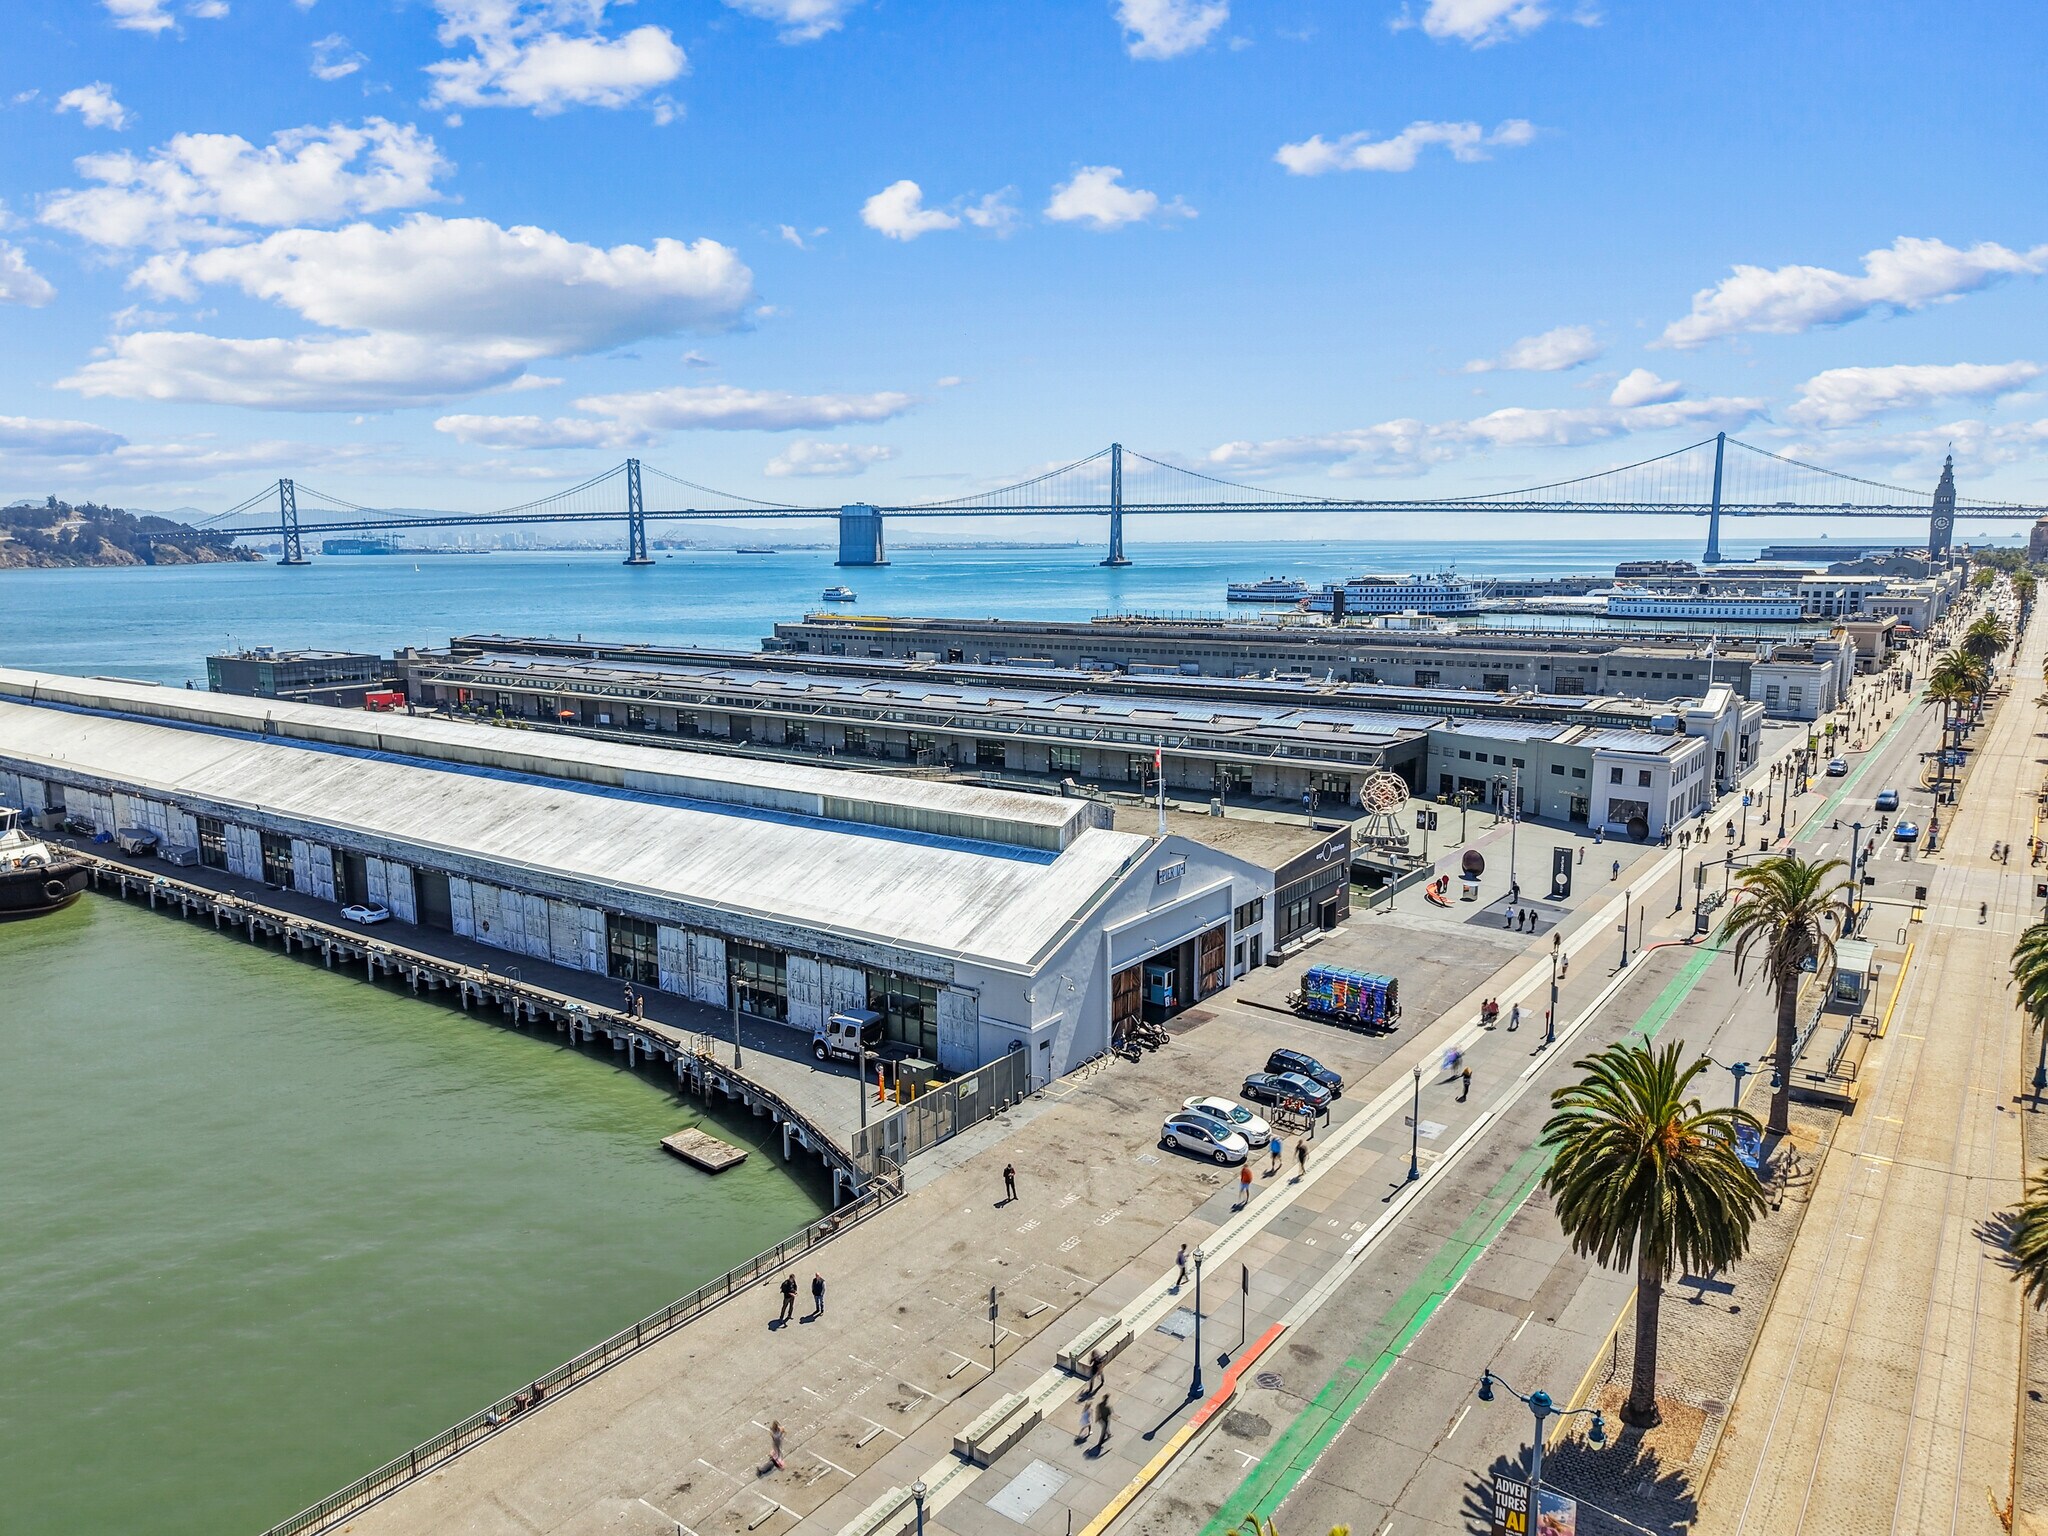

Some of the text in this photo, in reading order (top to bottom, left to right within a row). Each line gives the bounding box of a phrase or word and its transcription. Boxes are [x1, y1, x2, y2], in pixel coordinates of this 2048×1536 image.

[1161, 867, 1175, 882] PIER
[1708, 1127, 1729, 1140] TUR
[1016, 1218, 1042, 1234] FIRE
[1496, 1478, 1527, 1499] ADVEN
[1496, 1492, 1527, 1512] TURES
[1495, 1506, 1526, 1533] IN AI
